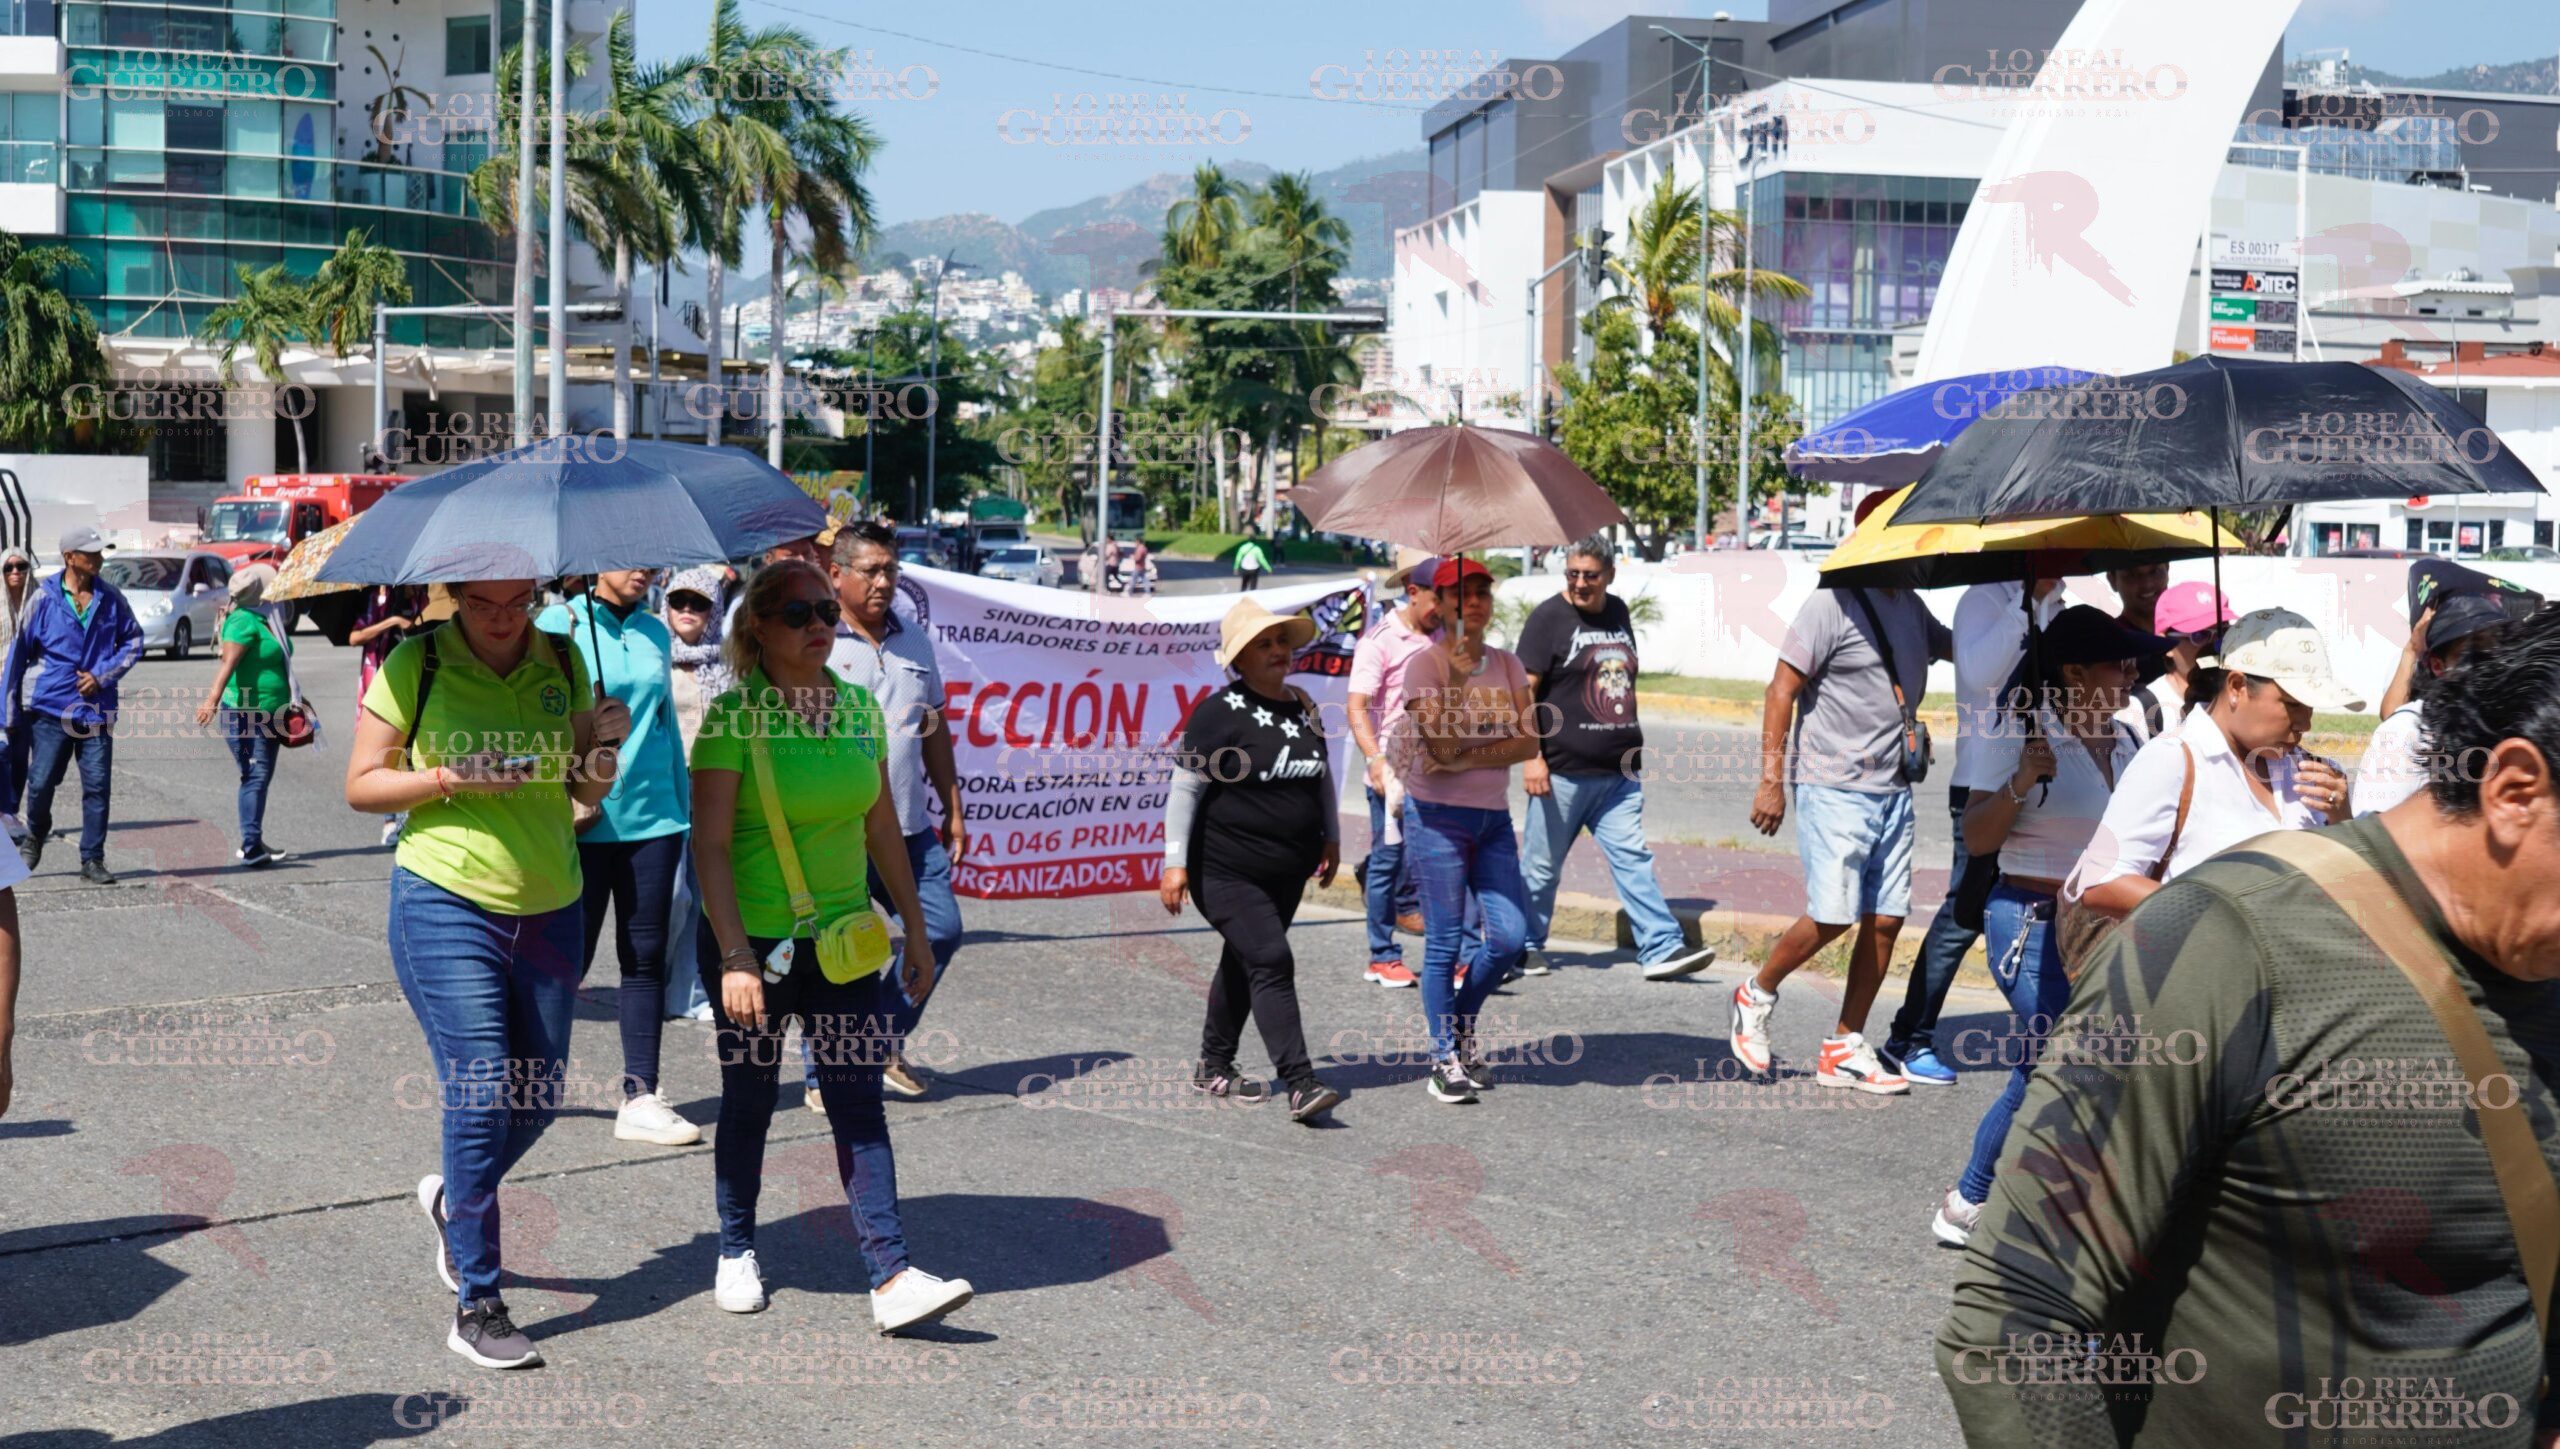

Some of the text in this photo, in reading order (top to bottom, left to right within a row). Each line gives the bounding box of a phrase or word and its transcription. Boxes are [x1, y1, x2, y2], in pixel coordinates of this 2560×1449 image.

[2231, 241, 2280, 255] ES 00317
[983, 607, 1210, 636] SINDICATO NACIONAL
[936, 625, 1097, 653] TRABAJADORES
[1103, 641, 1131, 655] DE
[1135, 642, 1159, 656] LA
[1024, 771, 1112, 792] ESTATAL
[1119, 770, 1146, 787] DE
[964, 793, 1094, 820] EDUCACIÓN
[1101, 794, 1131, 812] EN
[1007, 829, 1061, 854] 046
